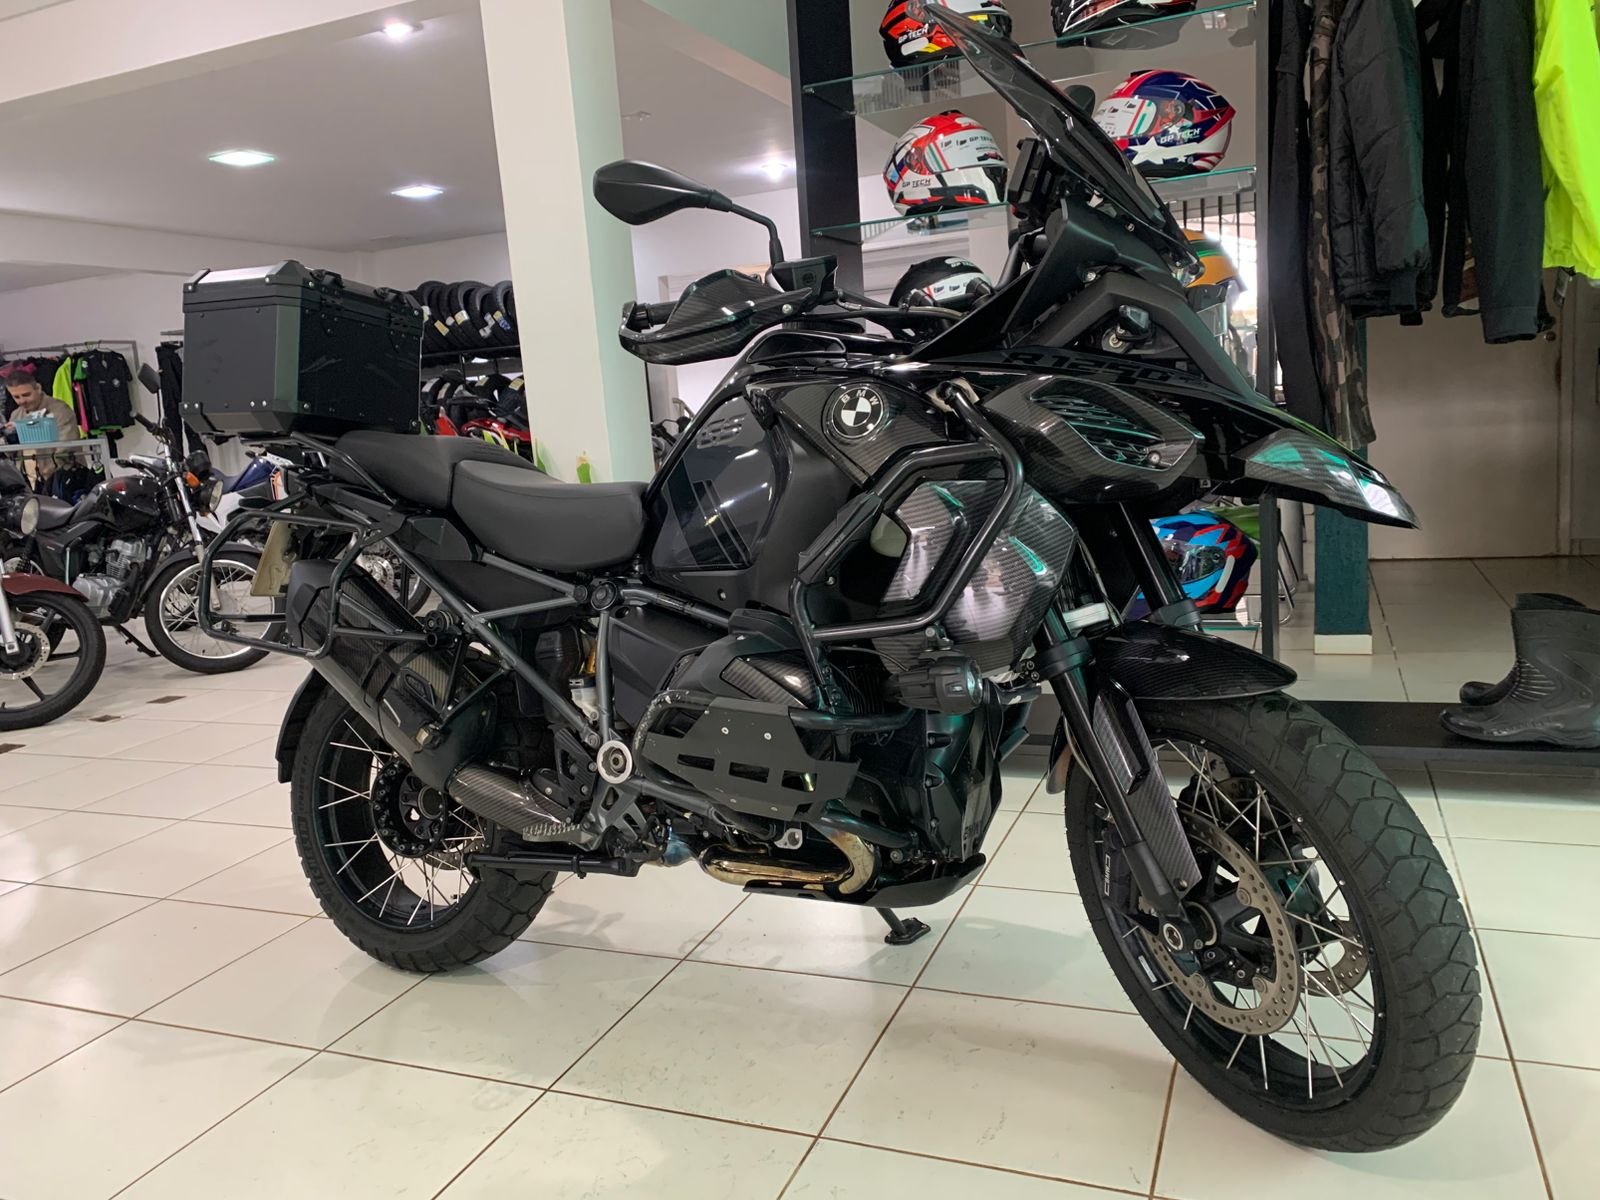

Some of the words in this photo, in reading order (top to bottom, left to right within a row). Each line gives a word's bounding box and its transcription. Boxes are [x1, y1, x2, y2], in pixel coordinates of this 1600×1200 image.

[908, 24, 928, 39] TECH
[912, 179, 931, 188] TECH
[840, 389, 880, 406] BMW
